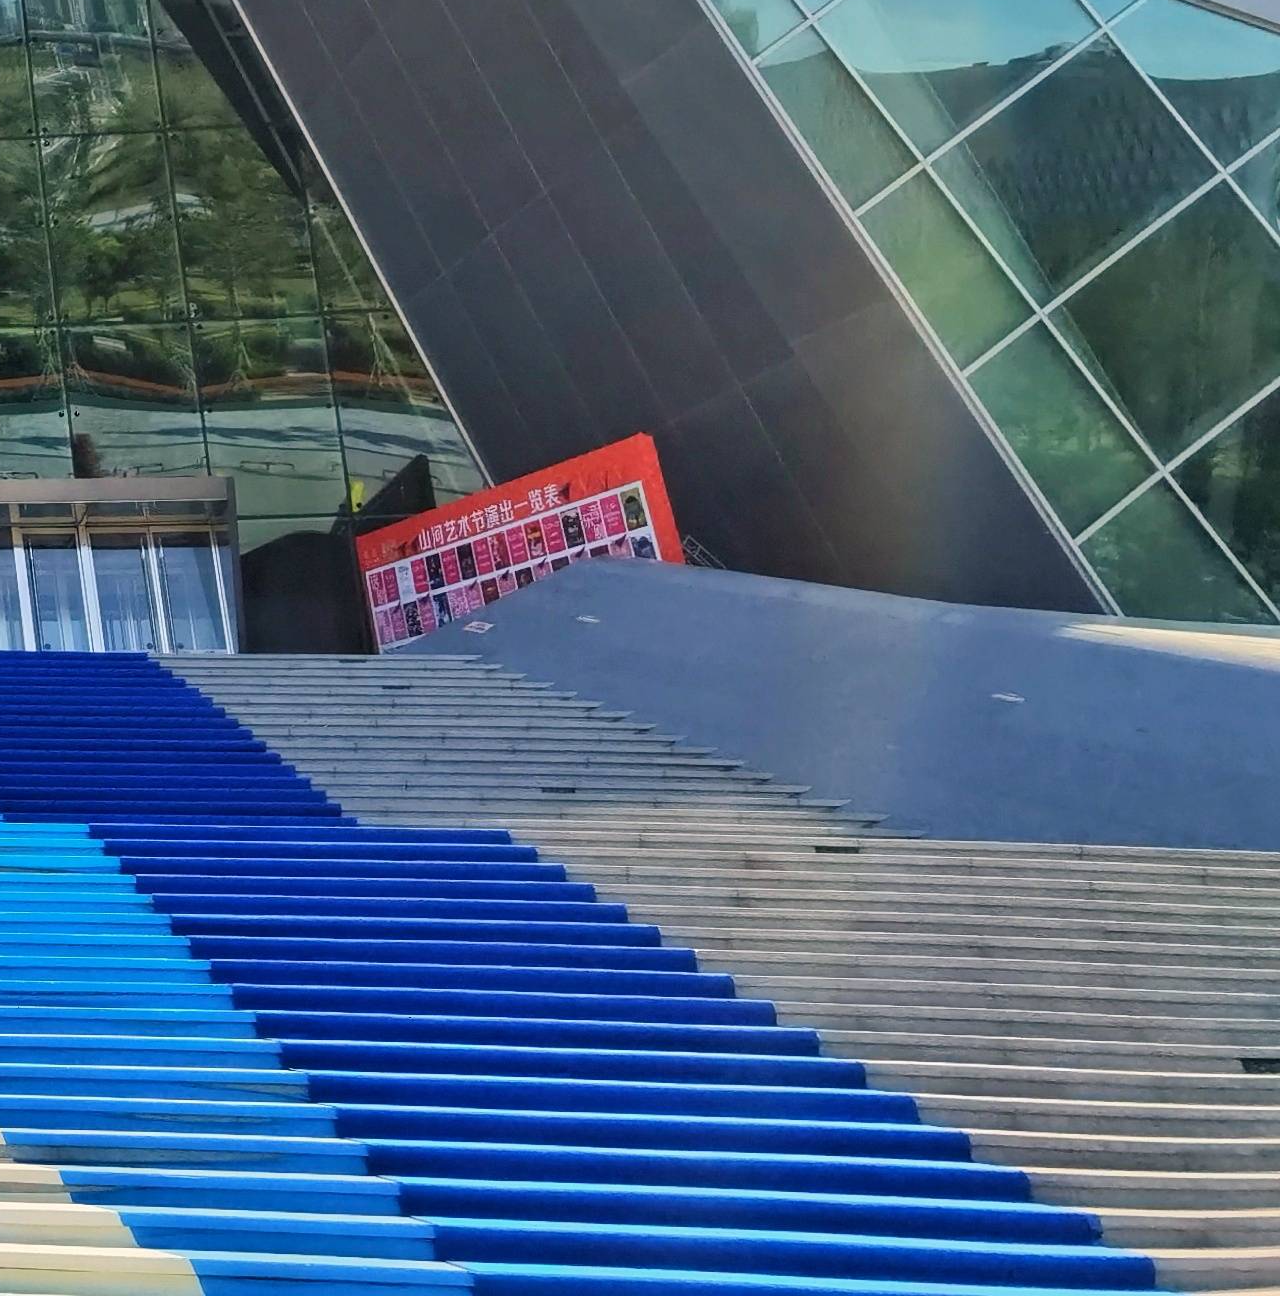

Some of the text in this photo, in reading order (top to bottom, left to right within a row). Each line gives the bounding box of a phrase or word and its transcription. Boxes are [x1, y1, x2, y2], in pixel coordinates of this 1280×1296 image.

[418, 483, 562, 550] 山河艺术节演出一览表
